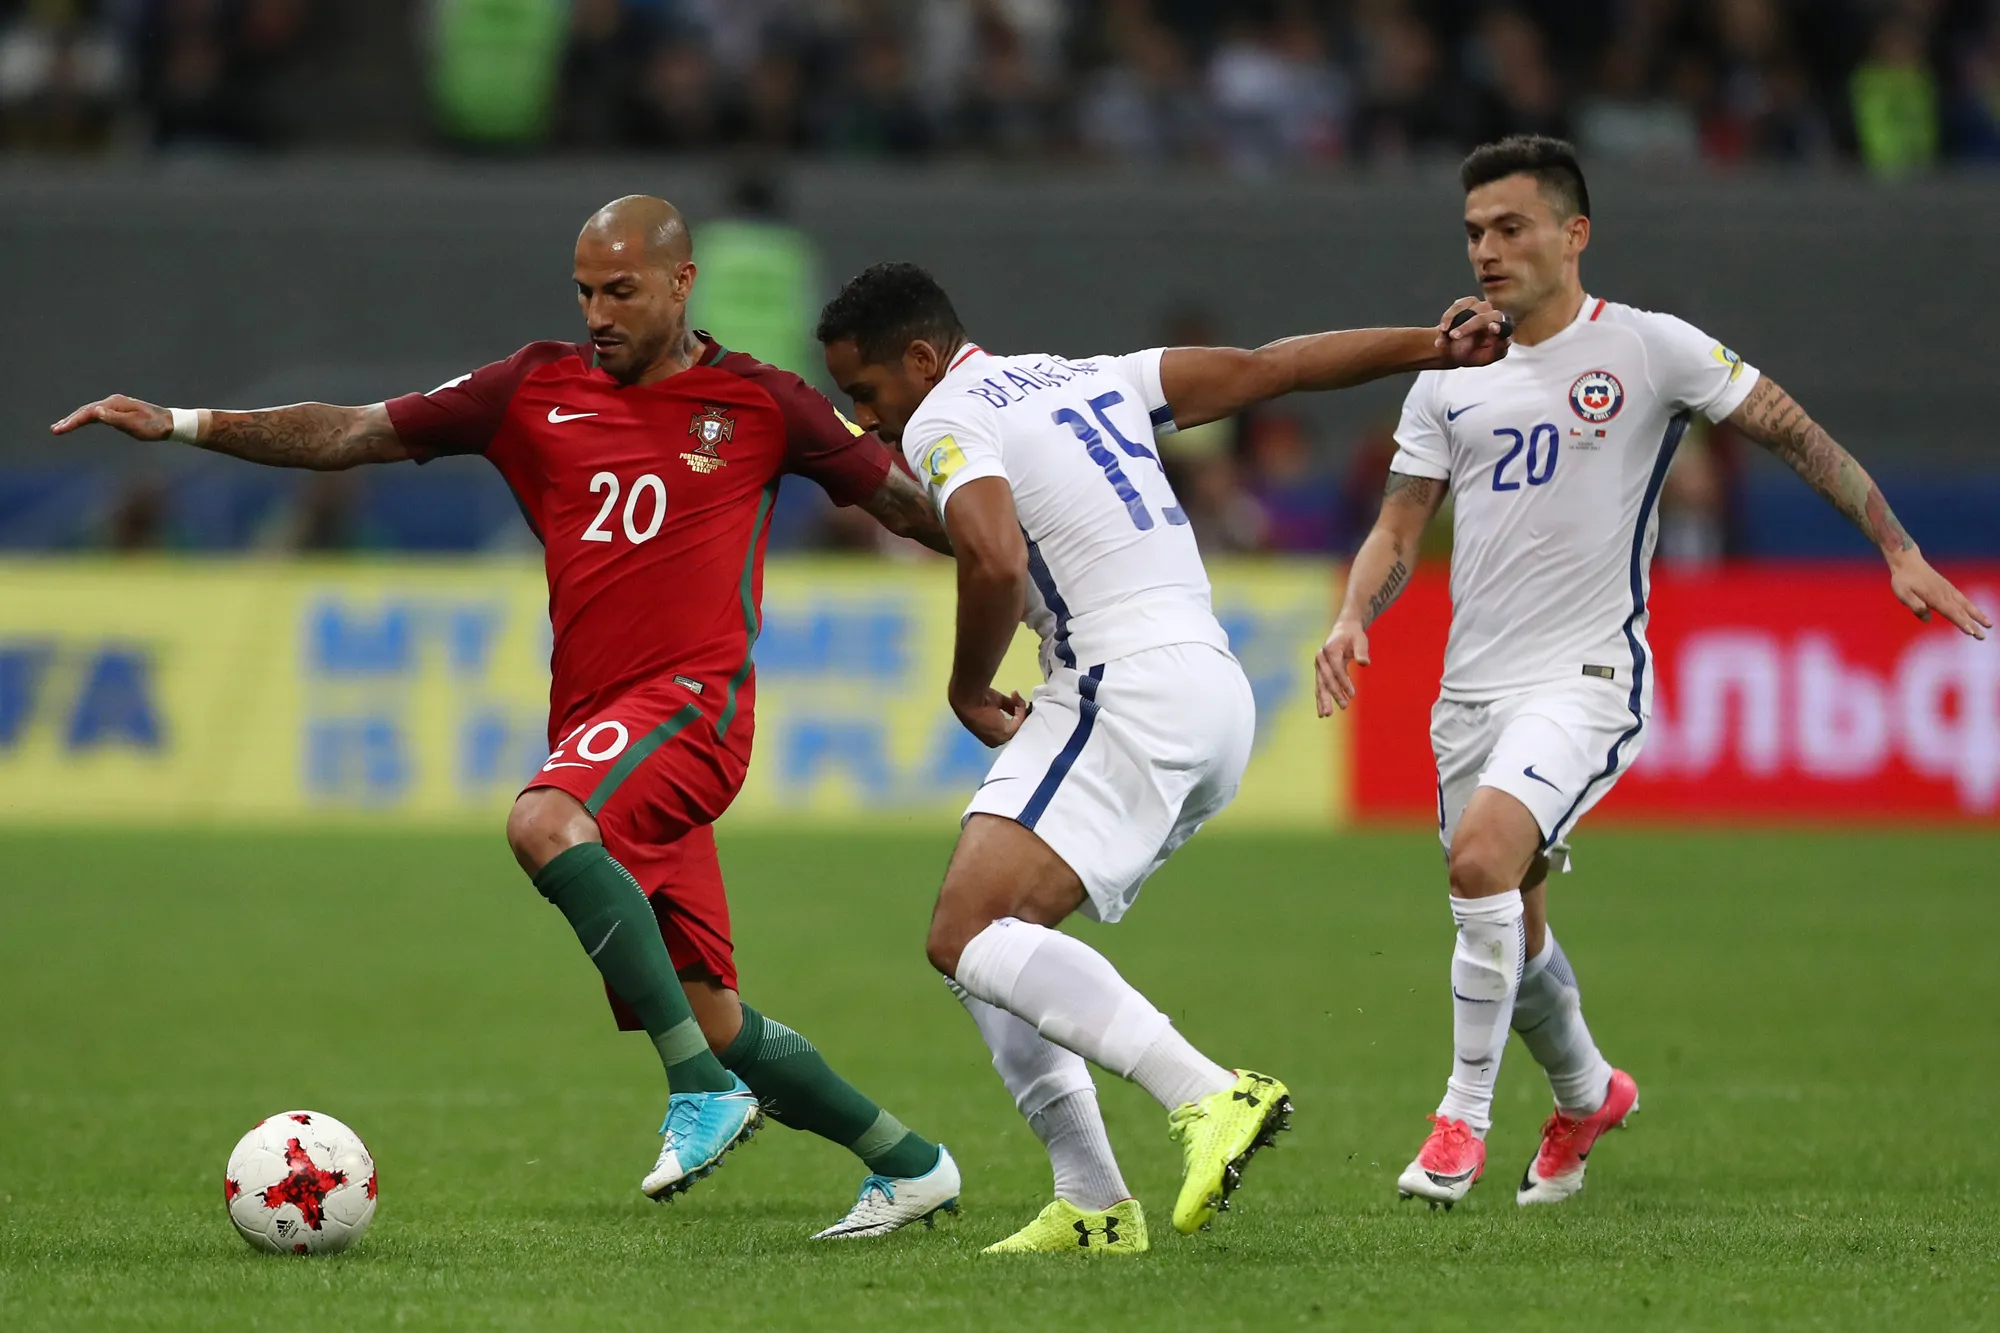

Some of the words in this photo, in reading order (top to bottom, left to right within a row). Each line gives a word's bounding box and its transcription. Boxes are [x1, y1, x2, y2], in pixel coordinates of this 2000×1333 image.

[1050, 390, 1189, 531] 15
[1492, 423, 1560, 492] 20
[580, 471, 667, 545] 20
[547, 720, 629, 763] 20
